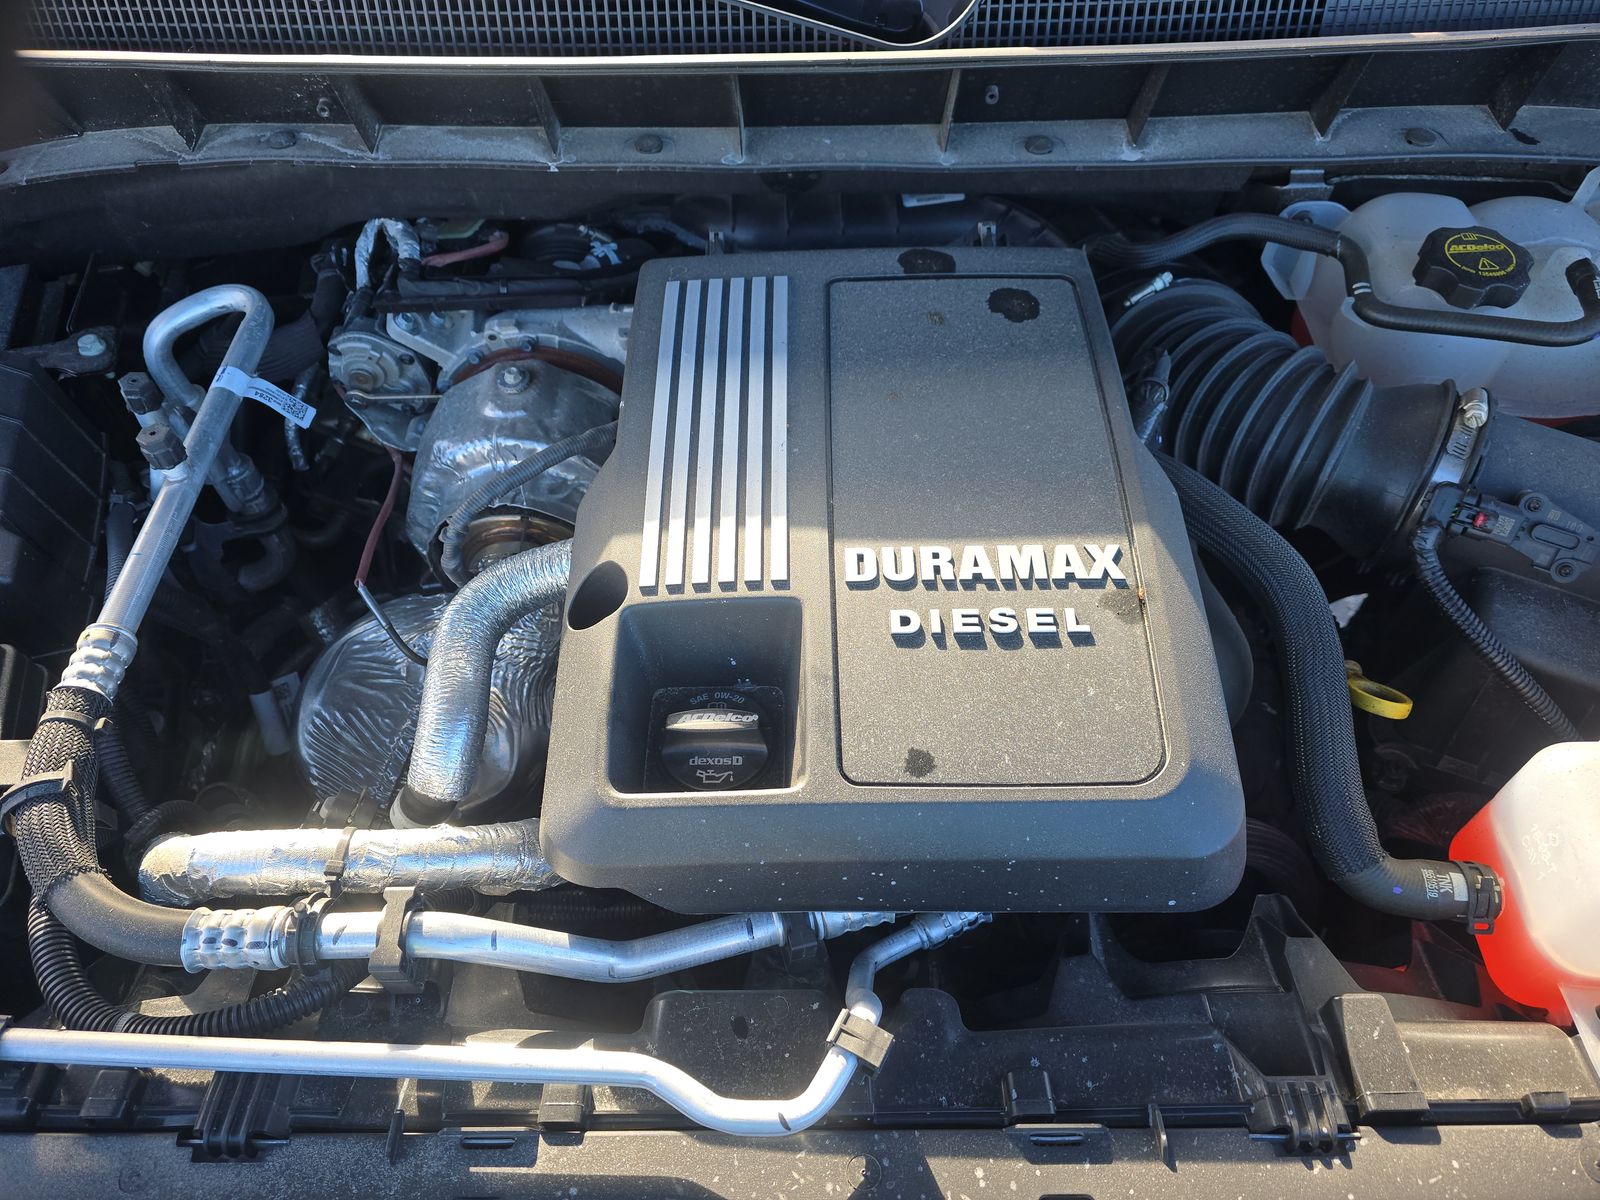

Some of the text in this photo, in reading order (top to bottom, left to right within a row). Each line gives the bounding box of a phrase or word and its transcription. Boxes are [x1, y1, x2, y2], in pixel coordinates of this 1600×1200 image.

[1449, 243, 1505, 252] ACDelco
[844, 544, 1127, 582] DURAMAX
[890, 607, 1091, 634] DIESEL
[689, 691, 745, 705] SAE 0W-20
[677, 712, 754, 723] ACDelco
[1436, 873, 1453, 894] TNK
